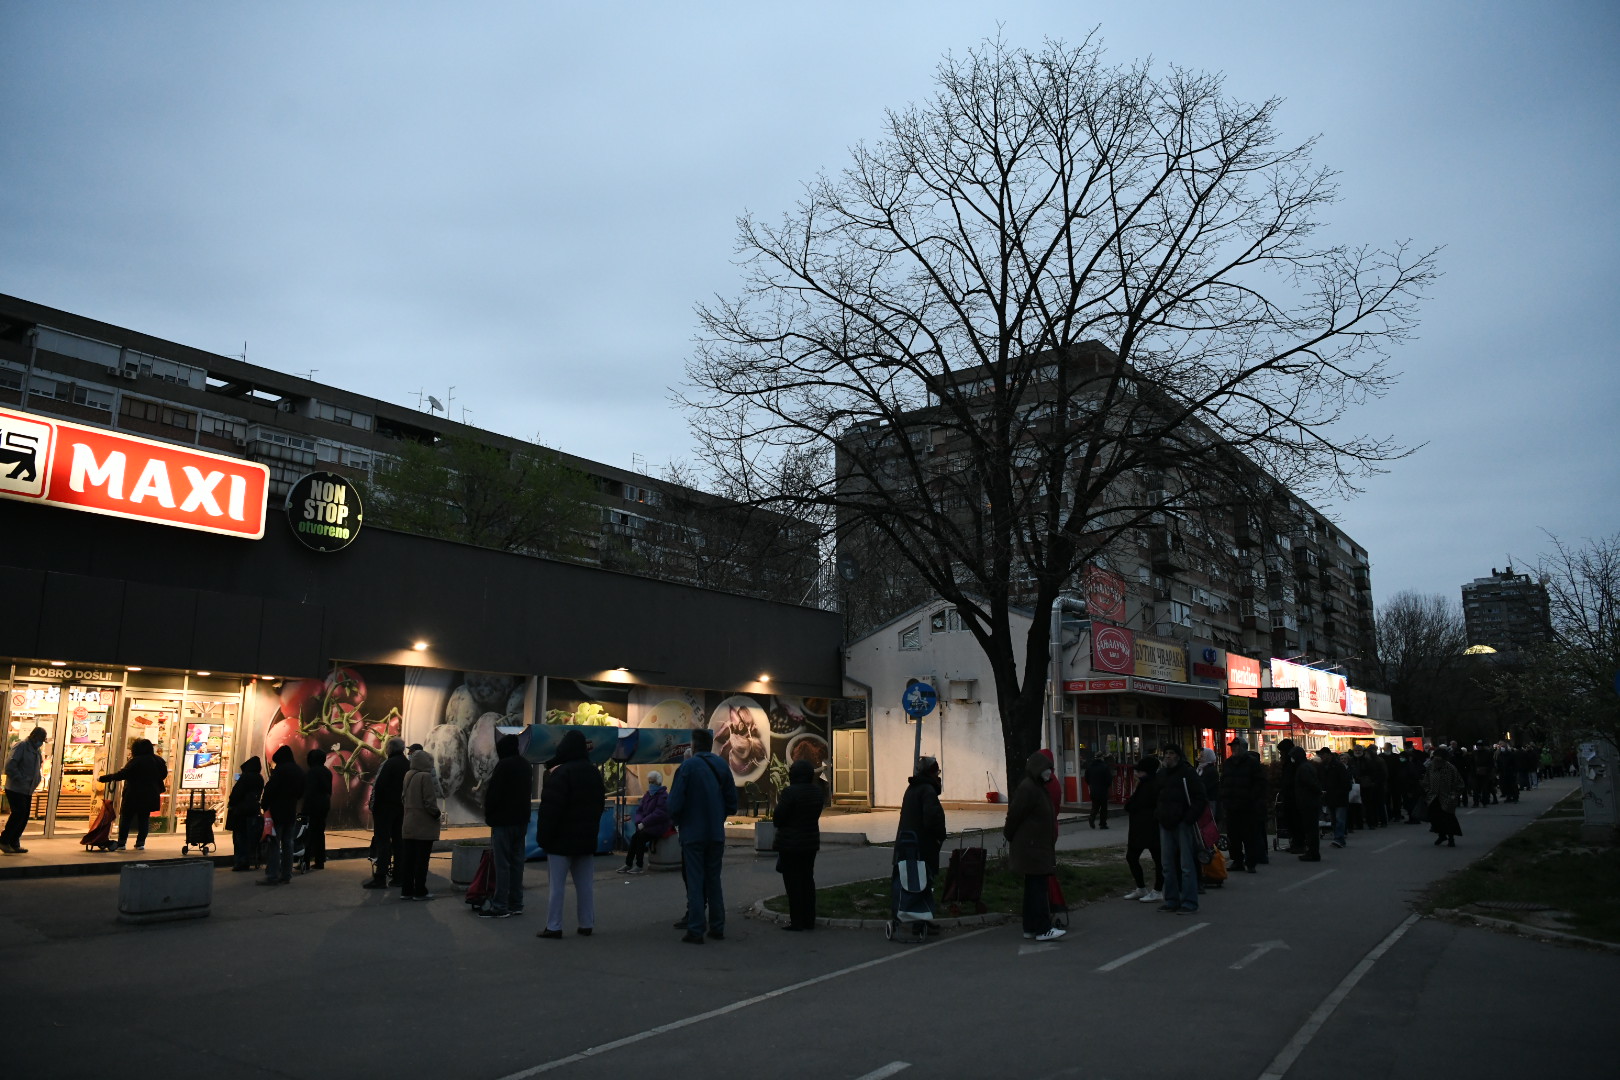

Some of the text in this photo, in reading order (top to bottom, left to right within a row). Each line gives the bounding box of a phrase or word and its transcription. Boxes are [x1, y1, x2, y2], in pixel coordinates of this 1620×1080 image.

[69, 442, 247, 521] MAXI
[310, 479, 346, 505] NON
[303, 498, 349, 525] STOP
[298, 520, 350, 540] otvoreno
[29, 667, 73, 678] DOBRO
[1230, 666, 1258, 687] meridian
